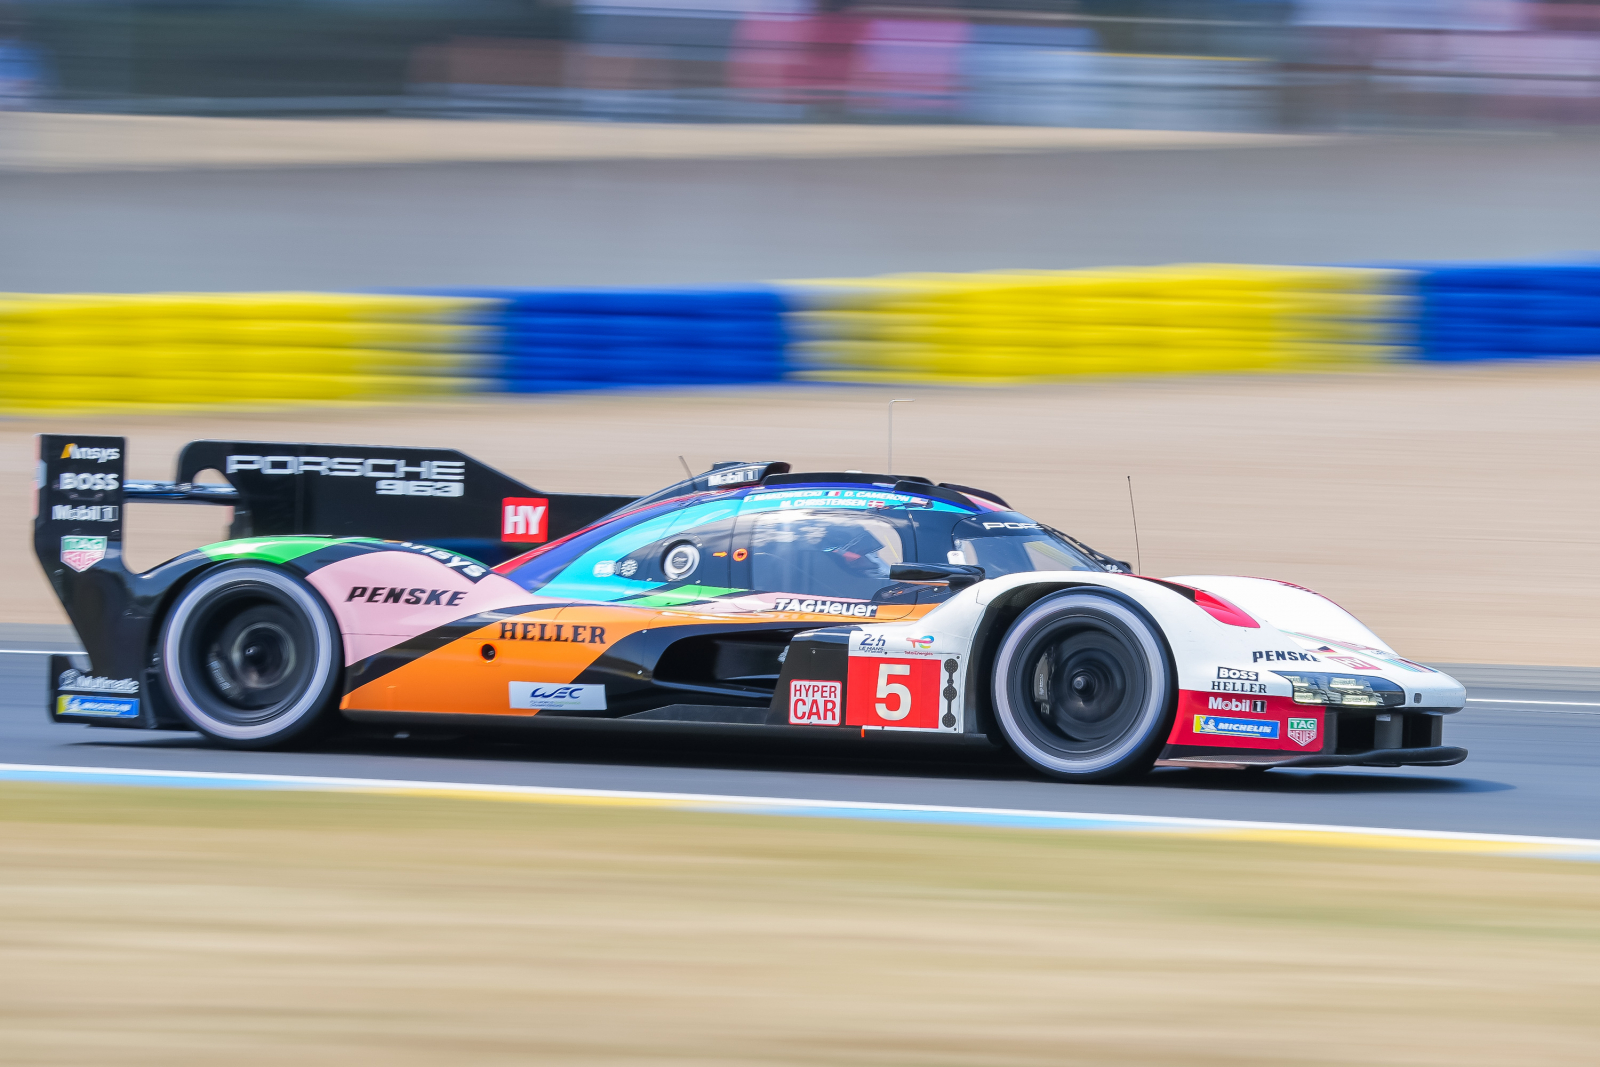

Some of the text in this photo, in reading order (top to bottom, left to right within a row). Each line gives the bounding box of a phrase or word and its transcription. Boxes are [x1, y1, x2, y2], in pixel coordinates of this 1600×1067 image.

[226, 455, 465, 480] PORSCHE
[59, 473, 119, 490] BOSS
[375, 480, 464, 497] 963
[794, 499, 866, 507] CHRISTENSEN
[856, 491, 910, 501] CAMERON
[503, 505, 546, 535] HY
[345, 586, 468, 606] PENSKE
[500, 621, 606, 644] HELLER
[1218, 668, 1258, 680] BOSS
[530, 687, 584, 699] WEC
[794, 684, 837, 699] HYPER
[875, 663, 912, 721] 5
[1211, 681, 1267, 693] HELLER
[793, 699, 836, 721] CAR
[1208, 697, 1250, 712] Mobil
[1217, 722, 1272, 733] MICHELIN
[1291, 720, 1315, 729] TAG
